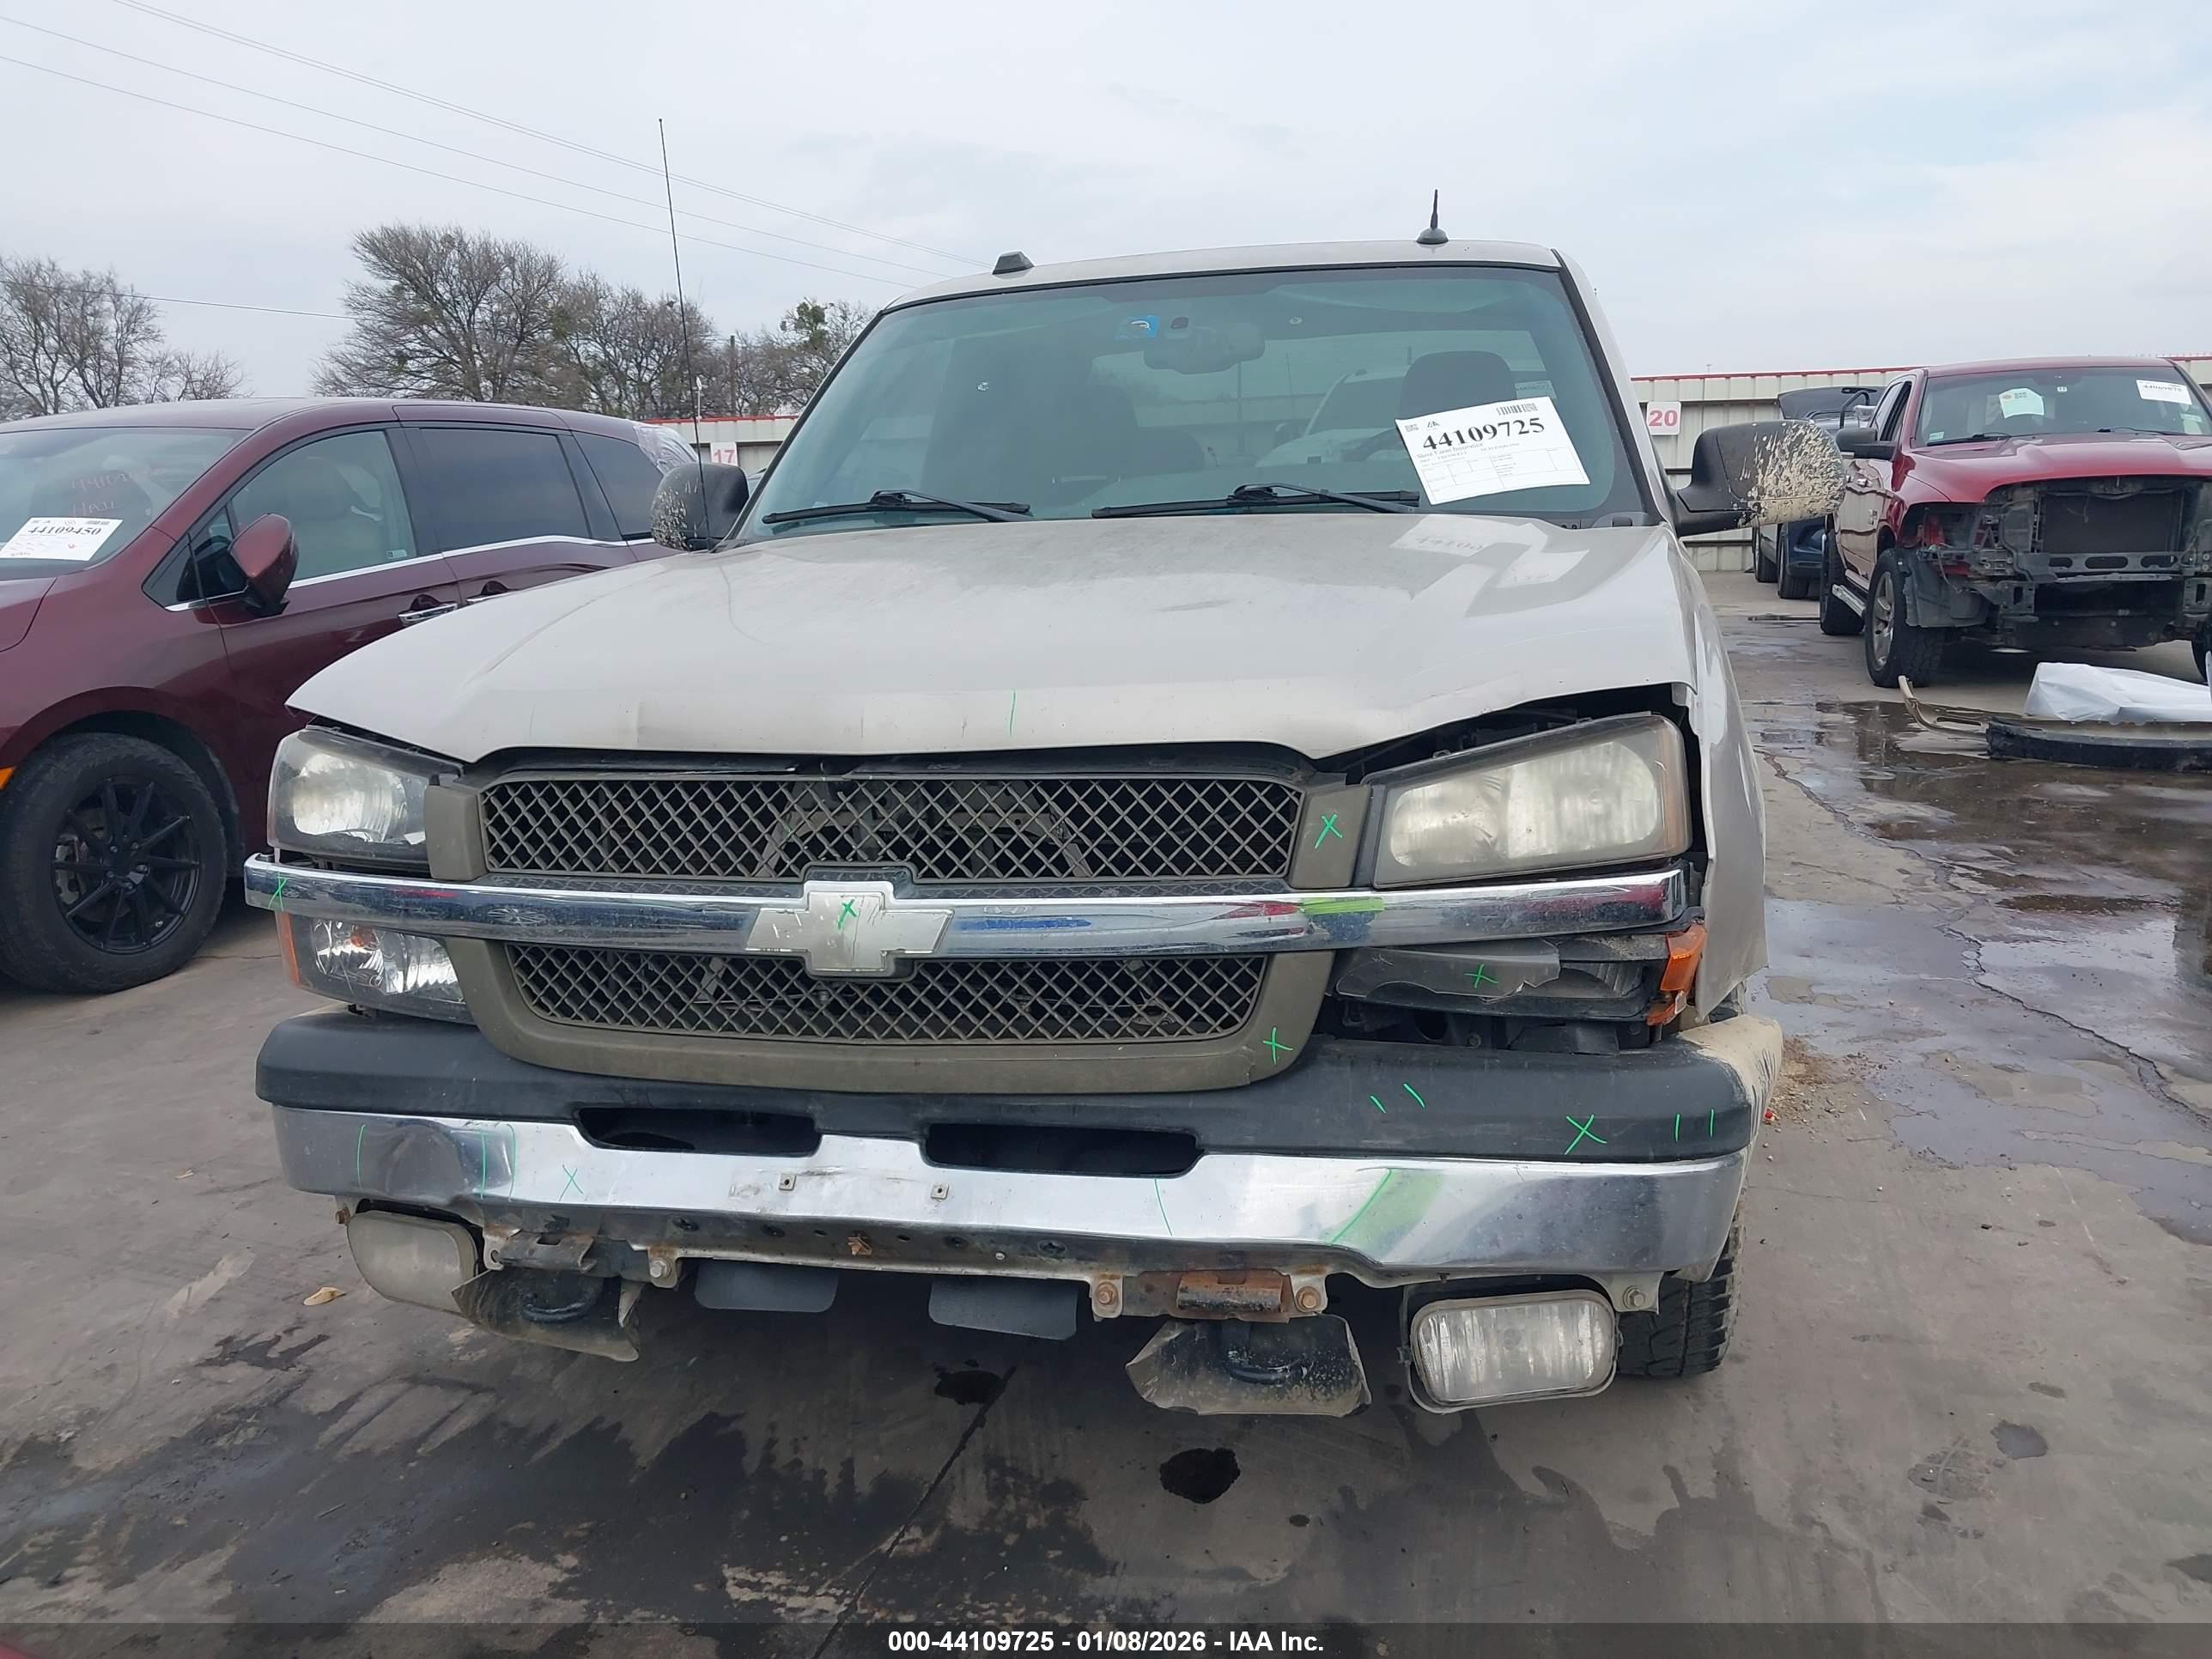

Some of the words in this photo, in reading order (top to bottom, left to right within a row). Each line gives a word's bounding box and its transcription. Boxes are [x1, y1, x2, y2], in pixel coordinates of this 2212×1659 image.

[1649, 410, 1678, 427] 20
[1423, 417, 1545, 450] 44109725
[714, 449, 735, 464] 17
[27, 526, 102, 536] 44109450
